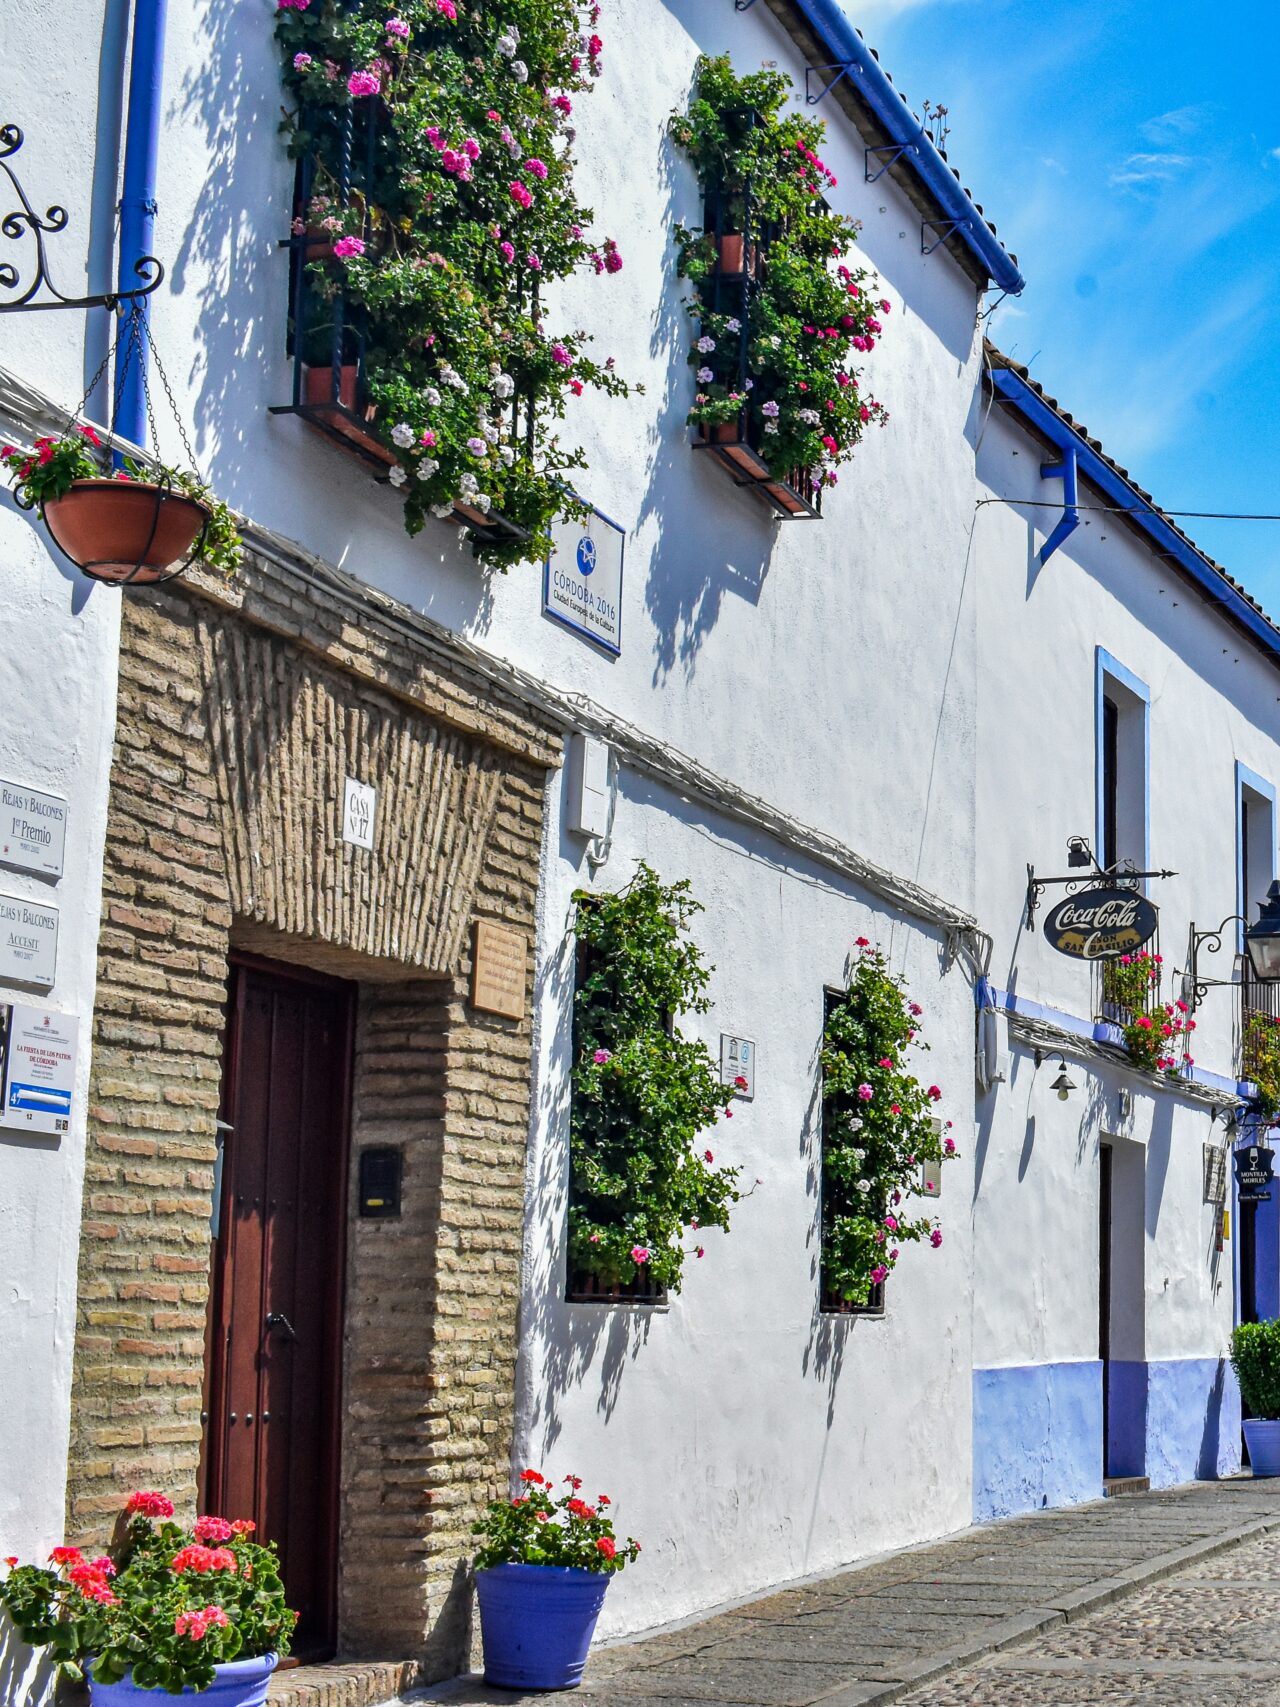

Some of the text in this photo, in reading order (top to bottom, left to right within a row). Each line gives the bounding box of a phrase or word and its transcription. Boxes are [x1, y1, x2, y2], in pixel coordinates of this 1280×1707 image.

[554, 570, 615, 621] CÓRDOBA 2016
[553, 589, 615, 634] Ciudad Europea de la Cultura
[2, 789, 63, 821] REJAS Y BALCONES
[350, 793, 368, 820] CASA
[21, 820, 52, 845] Premio
[359, 817, 368, 840] 17
[17, 909, 21, 922] Y
[23, 908, 55, 930] BALCONES
[1055, 899, 1140, 931] Coca-Cola
[1089, 938, 1135, 952] BASILIO
[16, 1044, 23, 1052] LA
[23, 1046, 39, 1056] FIESTA
[46, 1050, 55, 1058] LOS
[56, 1051, 72, 1061] PATIOS
[26, 1113, 33, 1121] 12
